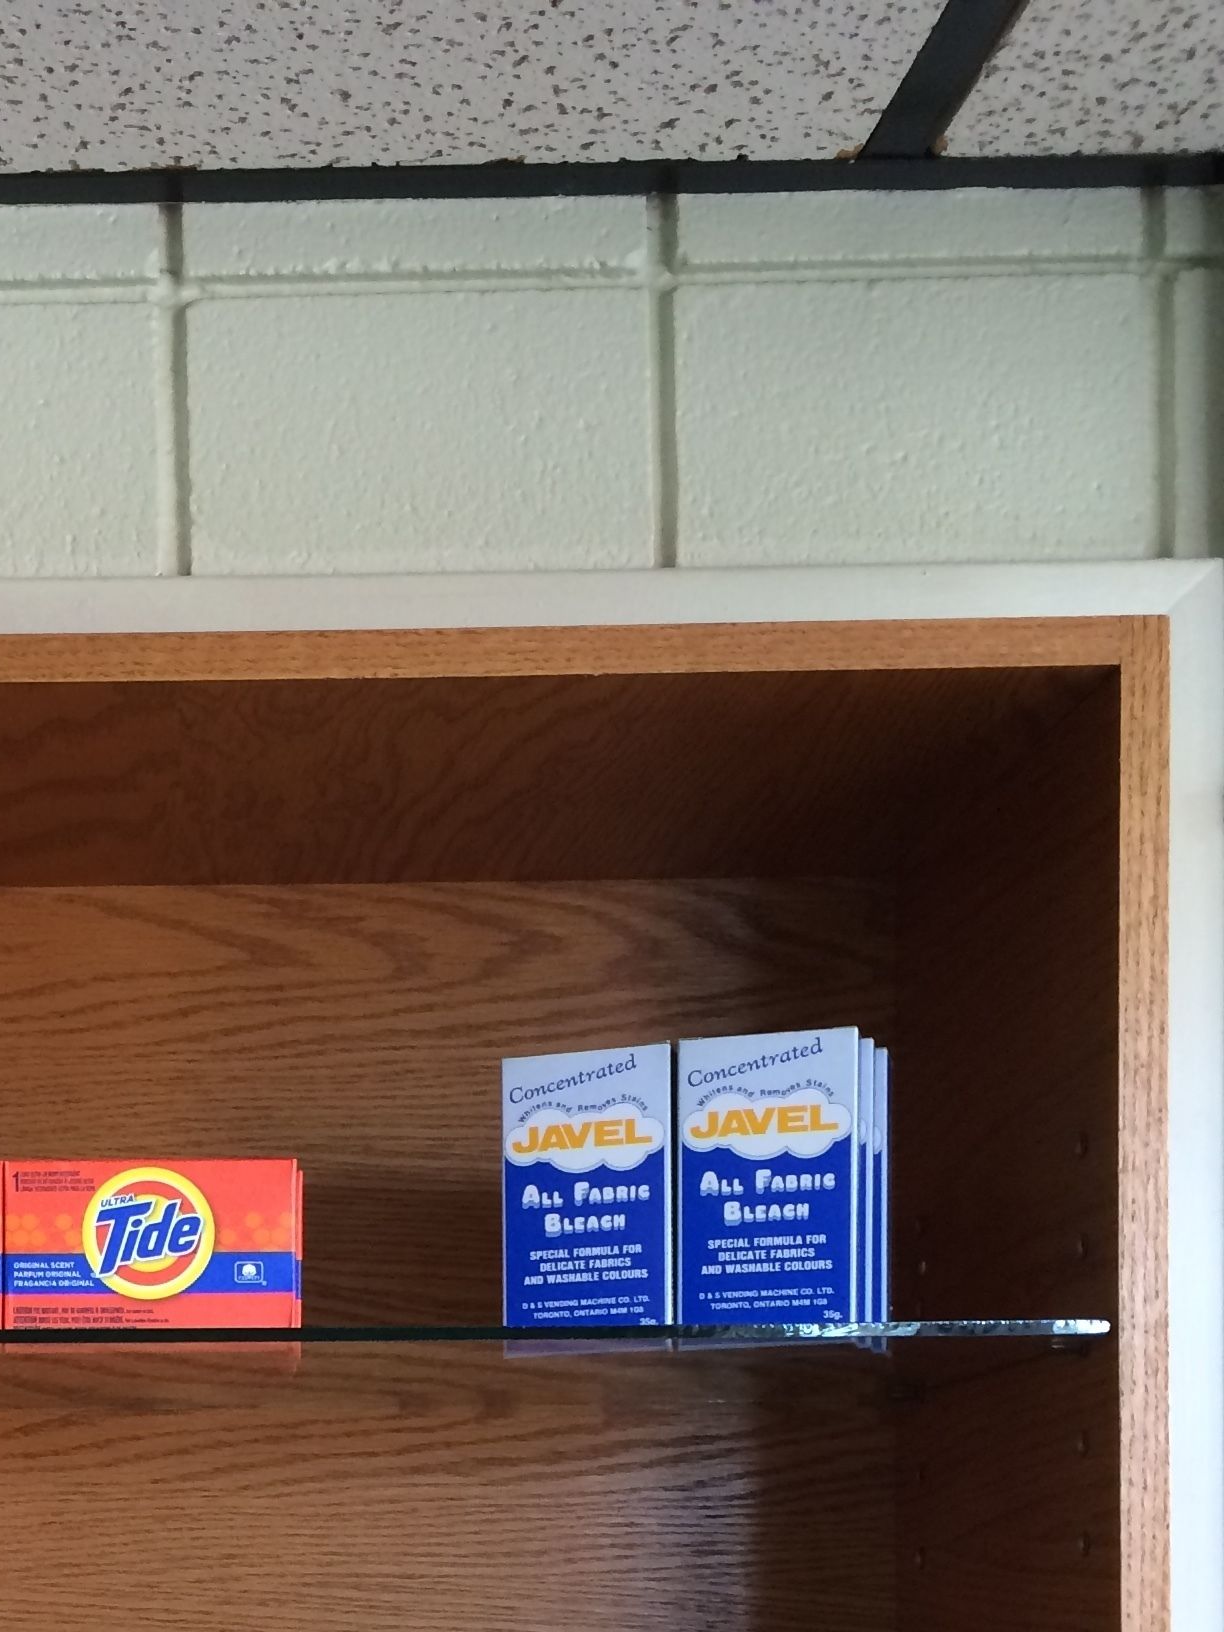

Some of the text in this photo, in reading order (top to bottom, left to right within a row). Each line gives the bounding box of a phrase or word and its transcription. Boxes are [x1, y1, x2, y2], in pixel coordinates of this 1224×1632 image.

[687, 1037, 823, 1088] Concentrated
[509, 1053, 637, 1104] Concentrated
[697, 1079, 834, 1107] Whitens and Removes Stains
[518, 1094, 648, 1123] Whitens and Removes Stains
[690, 1104, 839, 1139] JAVEL
[512, 1118, 652, 1153] JAVEL
[101, 1195, 134, 1207] ULTRA
[96, 1200, 204, 1277] Tide
[707, 1234, 826, 1249] SPECIAL FORMULA FOR
[529, 1244, 642, 1260] SPECIAL FORMULA FOR
[718, 1248, 815, 1262] DELICATE FABRICS
[13, 1261, 75, 1269] ORIGINAL SCENT
[540, 1257, 631, 1272] DELICATE FABRICS
[701, 1260, 833, 1275] AND WASHABLE COLOURS
[13, 1270, 81, 1279] PARFUM ORIGINAL
[524, 1269, 648, 1286] AND WASHABLE COLOURS
[58, 1279, 94, 1287] ORIGINAL
